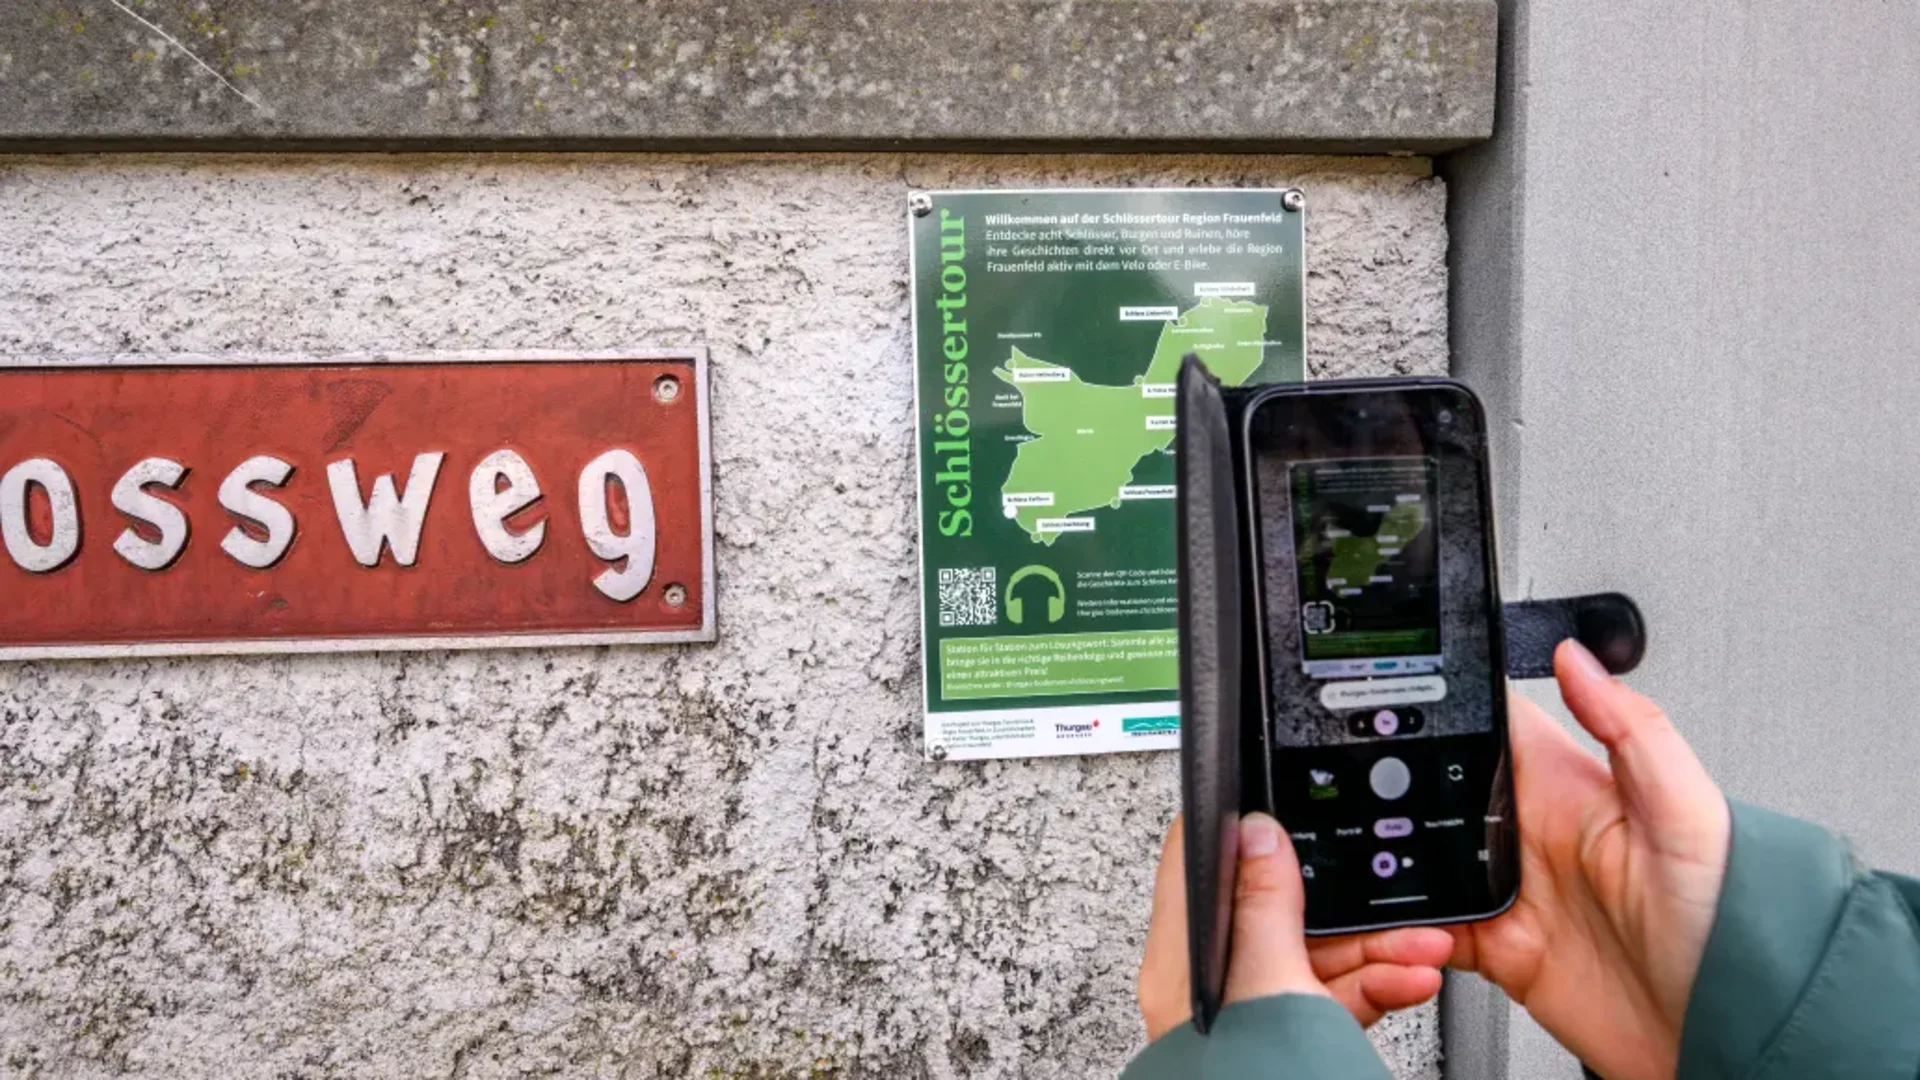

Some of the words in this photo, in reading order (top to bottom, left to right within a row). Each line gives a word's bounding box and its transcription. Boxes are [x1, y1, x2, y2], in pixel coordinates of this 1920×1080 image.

[985, 213, 1057, 224] Willkommen
[1060, 212, 1079, 224] auf
[1080, 212, 1100, 224] der
[1102, 211, 1180, 223] Schlössertour
[1182, 212, 1221, 225] Region
[1223, 212, 1283, 223] Frauenfeld
[986, 229, 1036, 241] Entdecke
[1038, 228, 1062, 240] acht
[1160, 228, 1182, 239] und
[1225, 228, 1251, 239] höre
[985, 246, 1008, 257] ihre
[1012, 245, 1079, 256] Geschichten
[1083, 245, 1115, 256] direkt
[1119, 247, 1137, 255] vor
[1141, 244, 1158, 255] Ort
[1163, 244, 1184, 255] und
[1188, 244, 1222, 255] erlebe
[1225, 243, 1243, 254] die
[1247, 243, 1283, 257] Region
[987, 261, 1045, 273] Frauenfeld
[1047, 260, 1072, 272] aktiv
[1074, 260, 1093, 271] mit
[1095, 260, 1120, 271] dem
[1122, 259, 1145, 271] Velo
[1147, 259, 1171, 270] oder
[1173, 259, 1210, 270] E-Bike.
[934, 208, 972, 537] Schlössertour
[0, 448, 656, 604] ossweg
[946, 644, 979, 655] Station
[994, 643, 1027, 653] Station
[1028, 642, 1049, 652] zum
[946, 658, 976, 669] bringe
[973, 668, 1023, 679] attraktiven
[1024, 666, 1049, 676] Preis!
[1055, 723, 1093, 734] Thurgau
